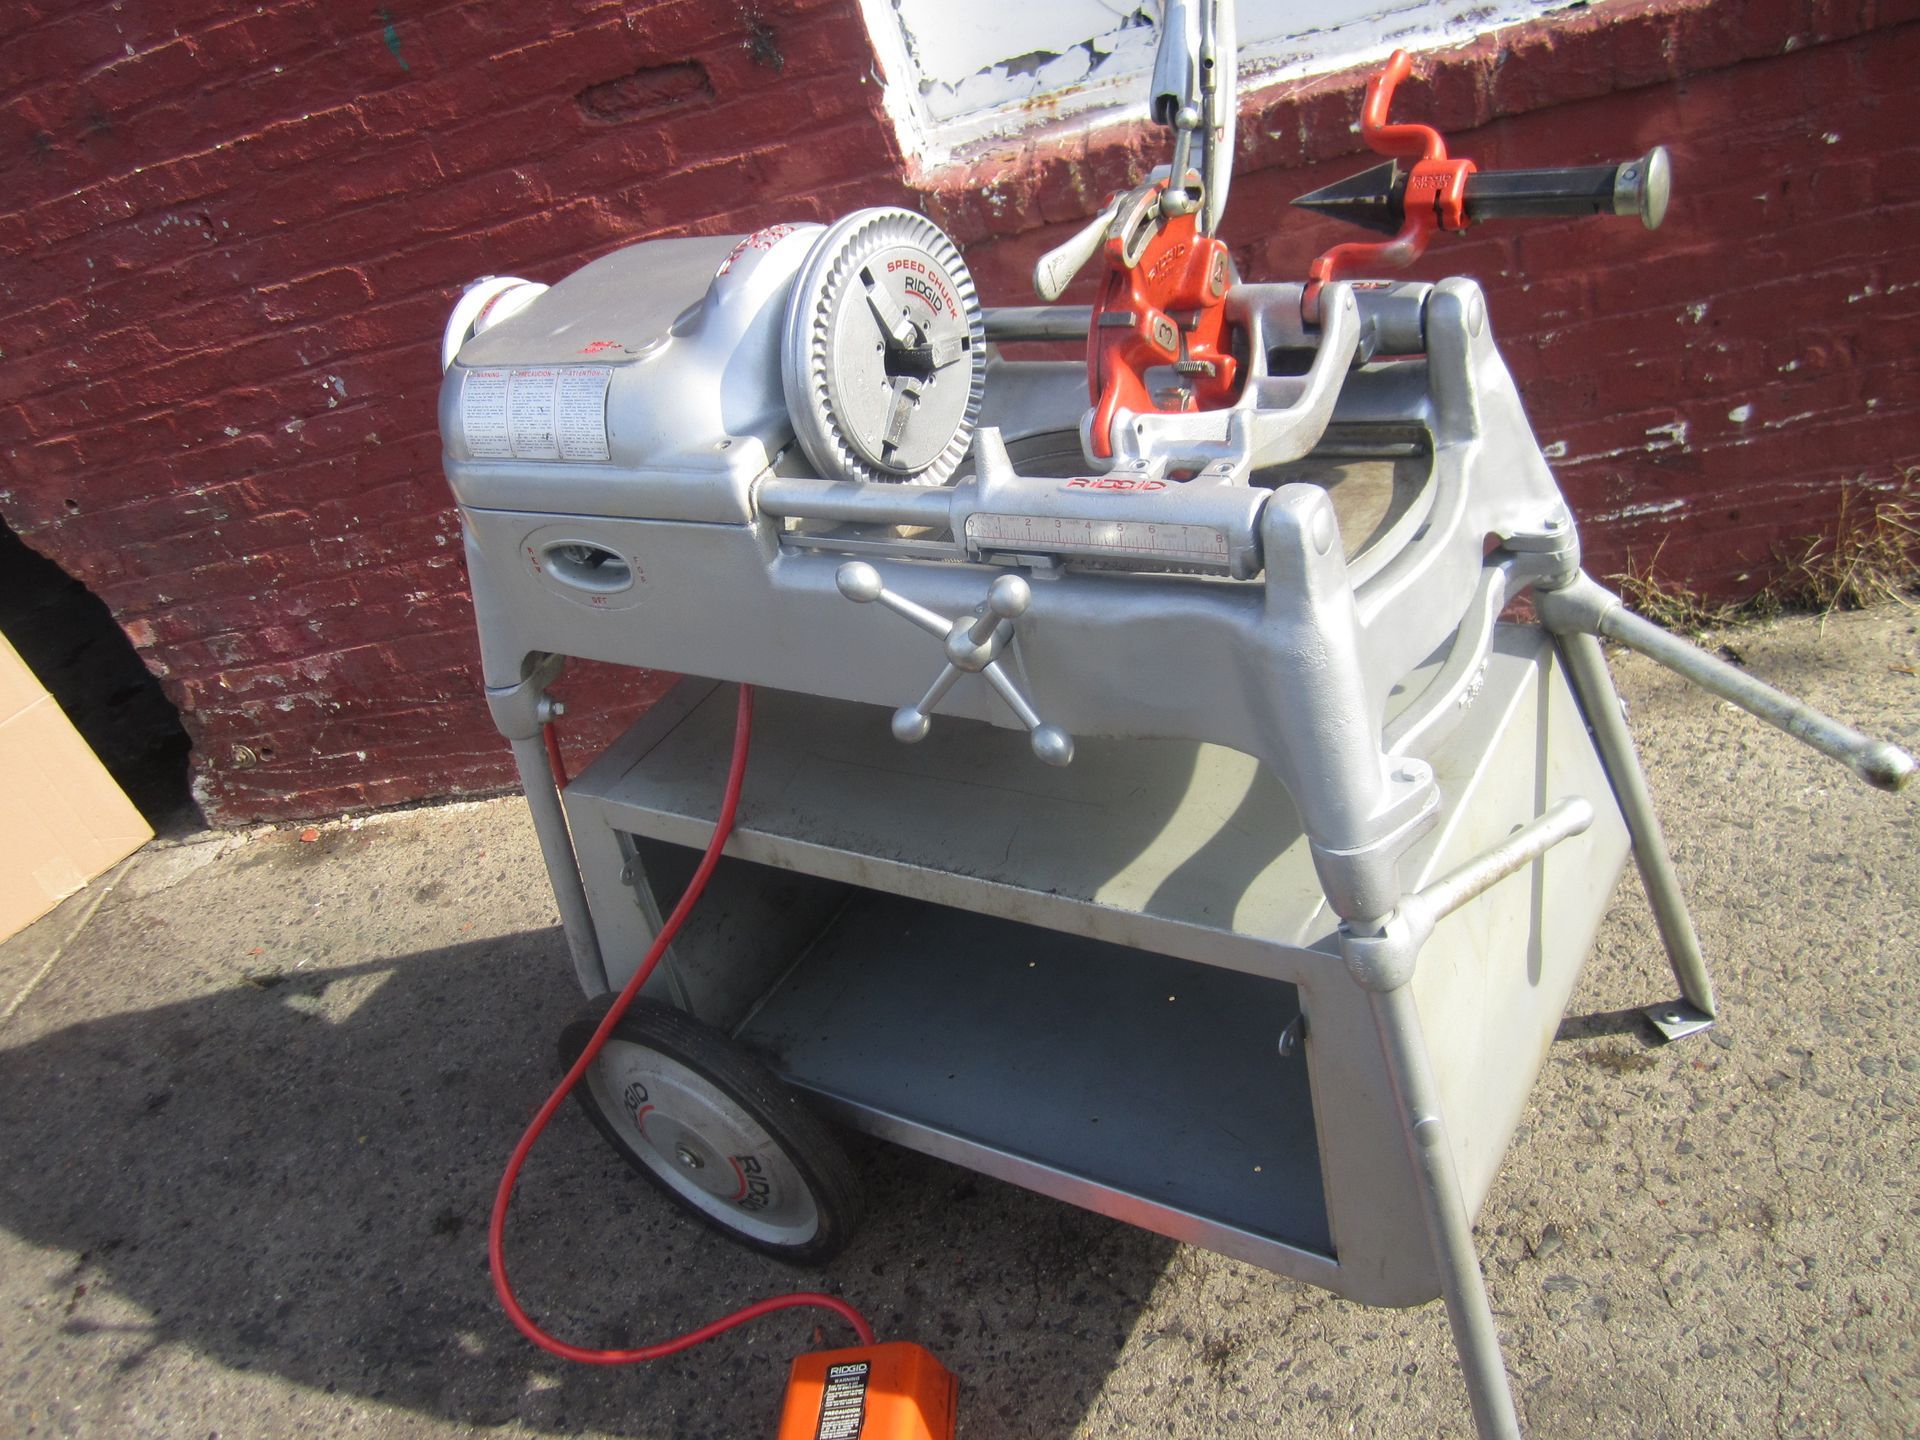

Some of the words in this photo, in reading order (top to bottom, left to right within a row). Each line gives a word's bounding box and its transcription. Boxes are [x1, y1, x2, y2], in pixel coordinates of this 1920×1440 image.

[1148, 243, 1185, 280] RIDGID
[887, 259, 926, 272] SPEED
[928, 271, 958, 321] CHUCK
[905, 276, 943, 311] RIDGID
[1159, 323, 1173, 344] 3
[1067, 478, 1168, 490] RIDGID
[1024, 518, 1031, 526] 2
[1054, 519, 1061, 528] 3
[1085, 521, 1091, 529] 4
[1117, 523, 1123, 531] 5
[1148, 525, 1155, 534] 6
[735, 1156, 770, 1211] RIDGID
[831, 1363, 867, 1376] RIDGID
